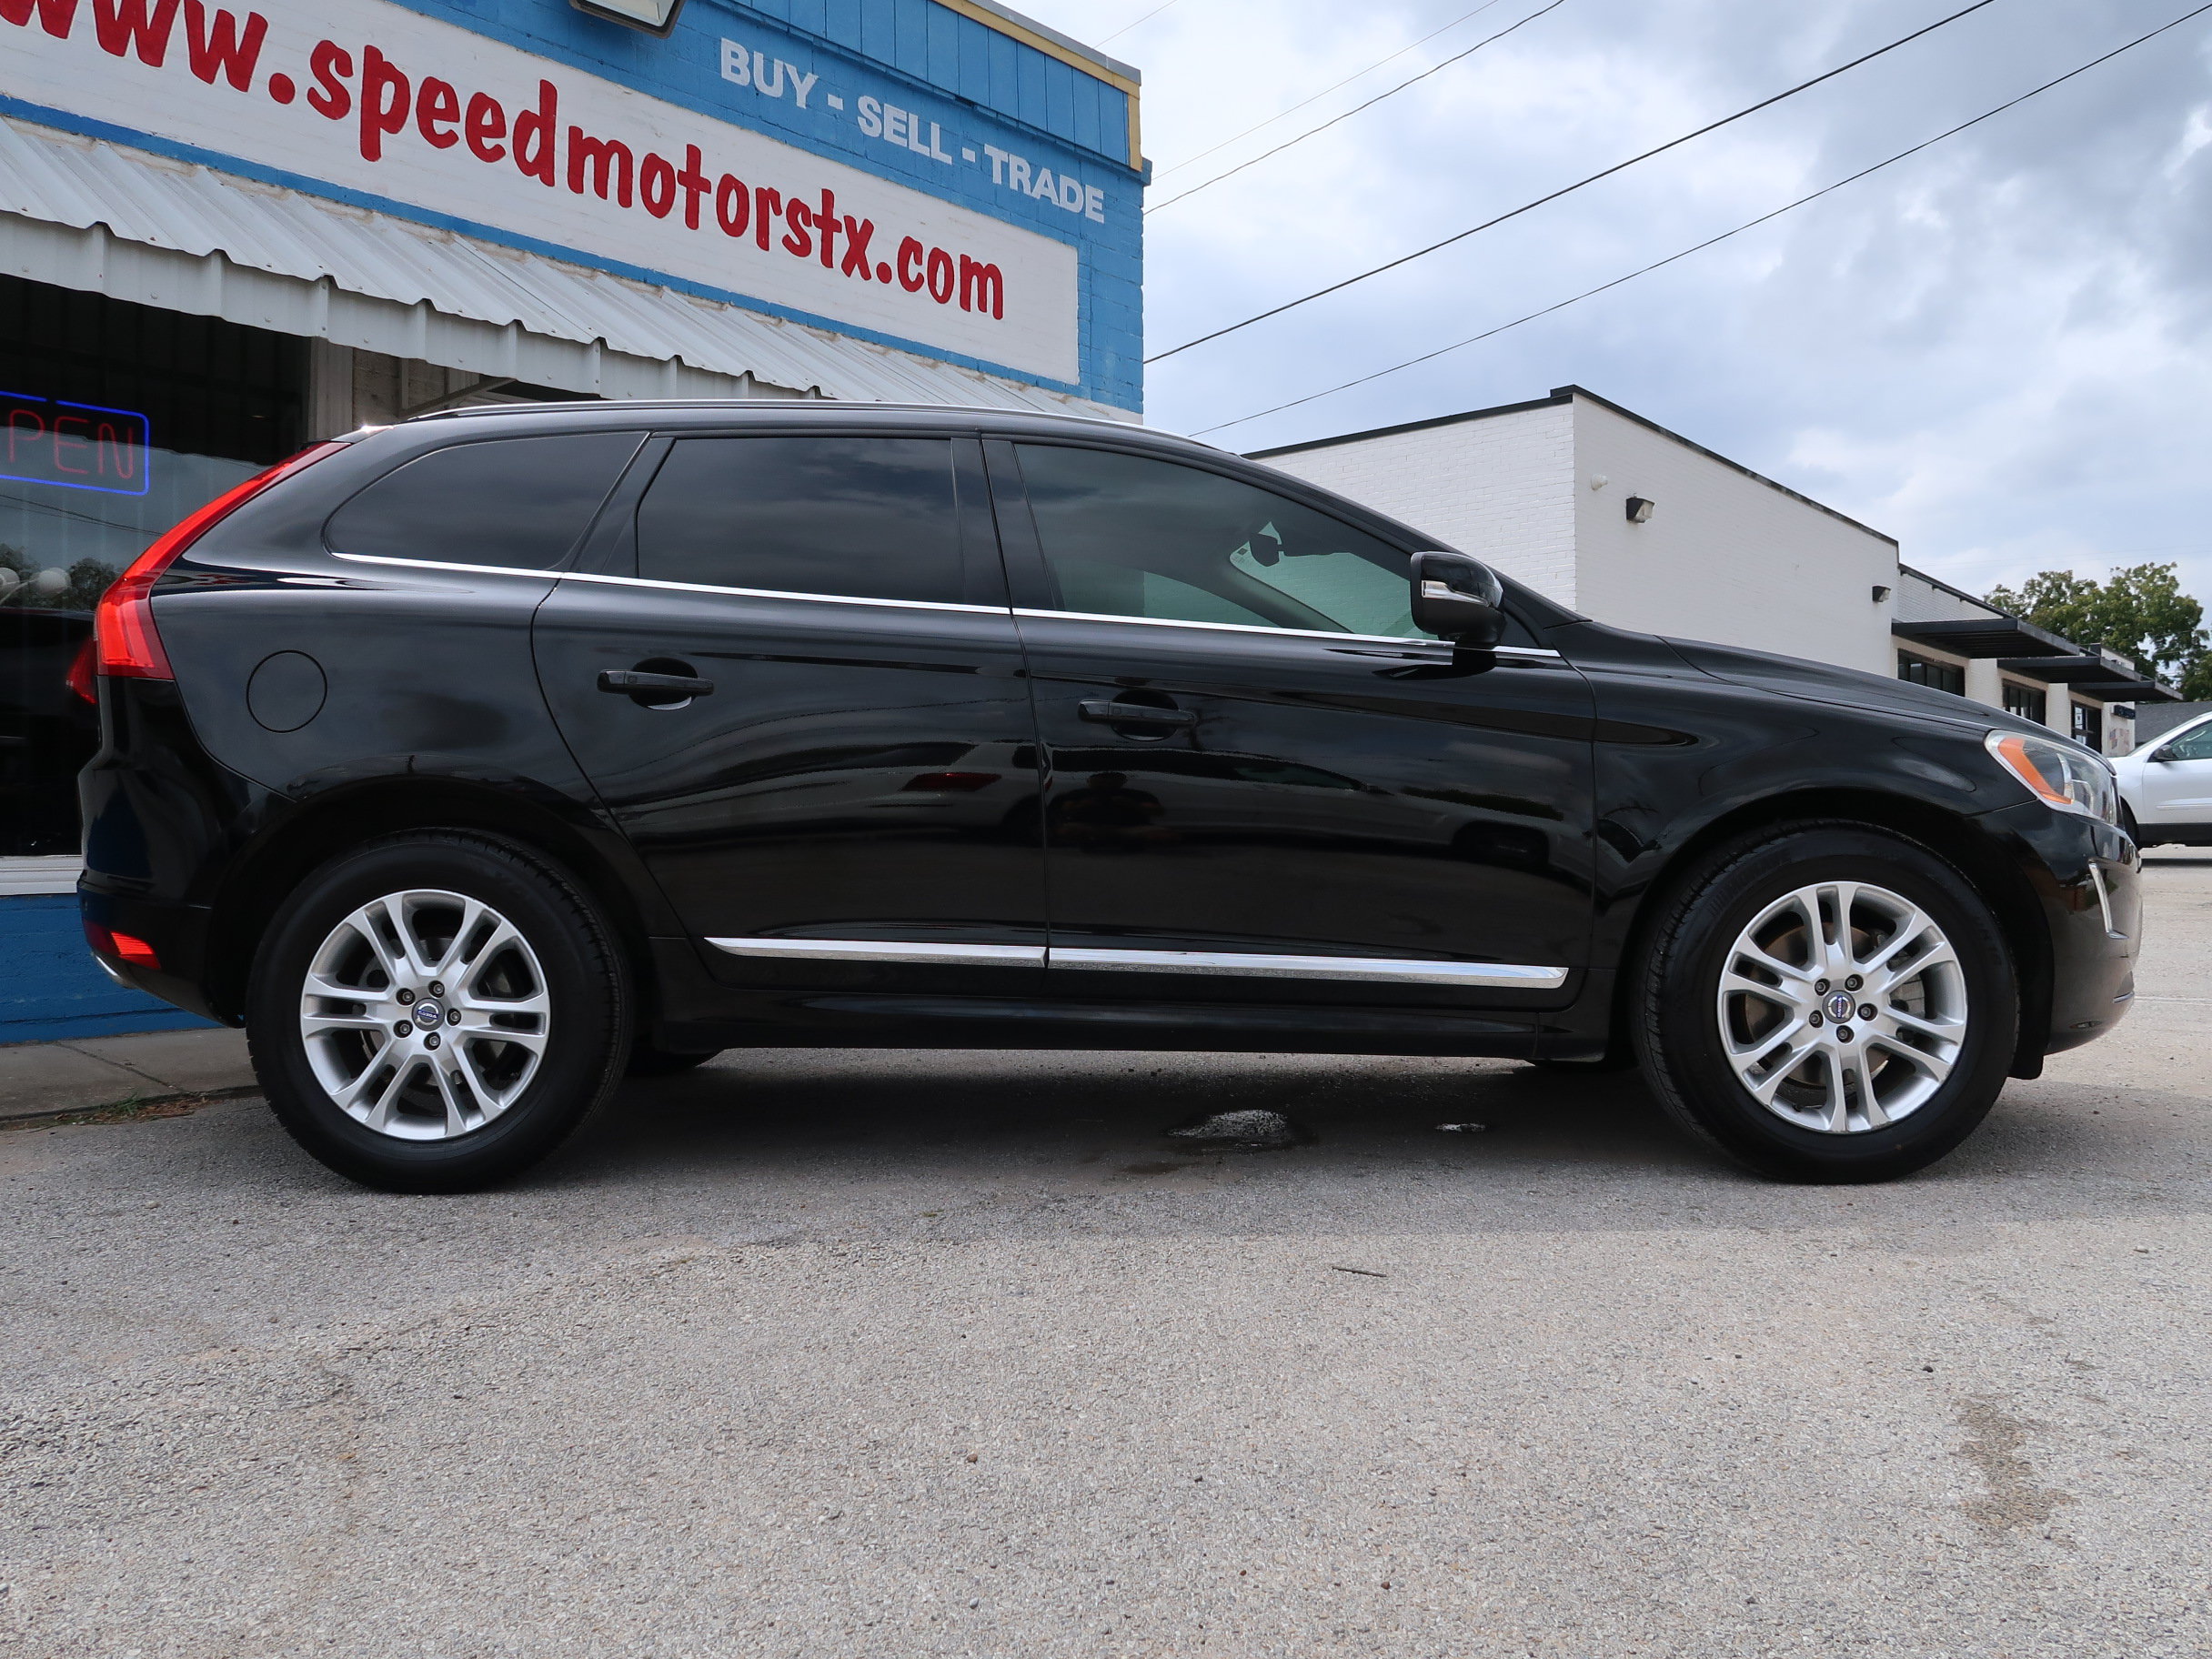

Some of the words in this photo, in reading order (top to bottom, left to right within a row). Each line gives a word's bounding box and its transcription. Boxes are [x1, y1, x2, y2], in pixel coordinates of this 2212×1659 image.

[720, 38, 818, 109] BUY
[857, 96, 952, 165] SELL
[984, 144, 1105, 224] TRADE
[8, 408, 134, 479] PEN
